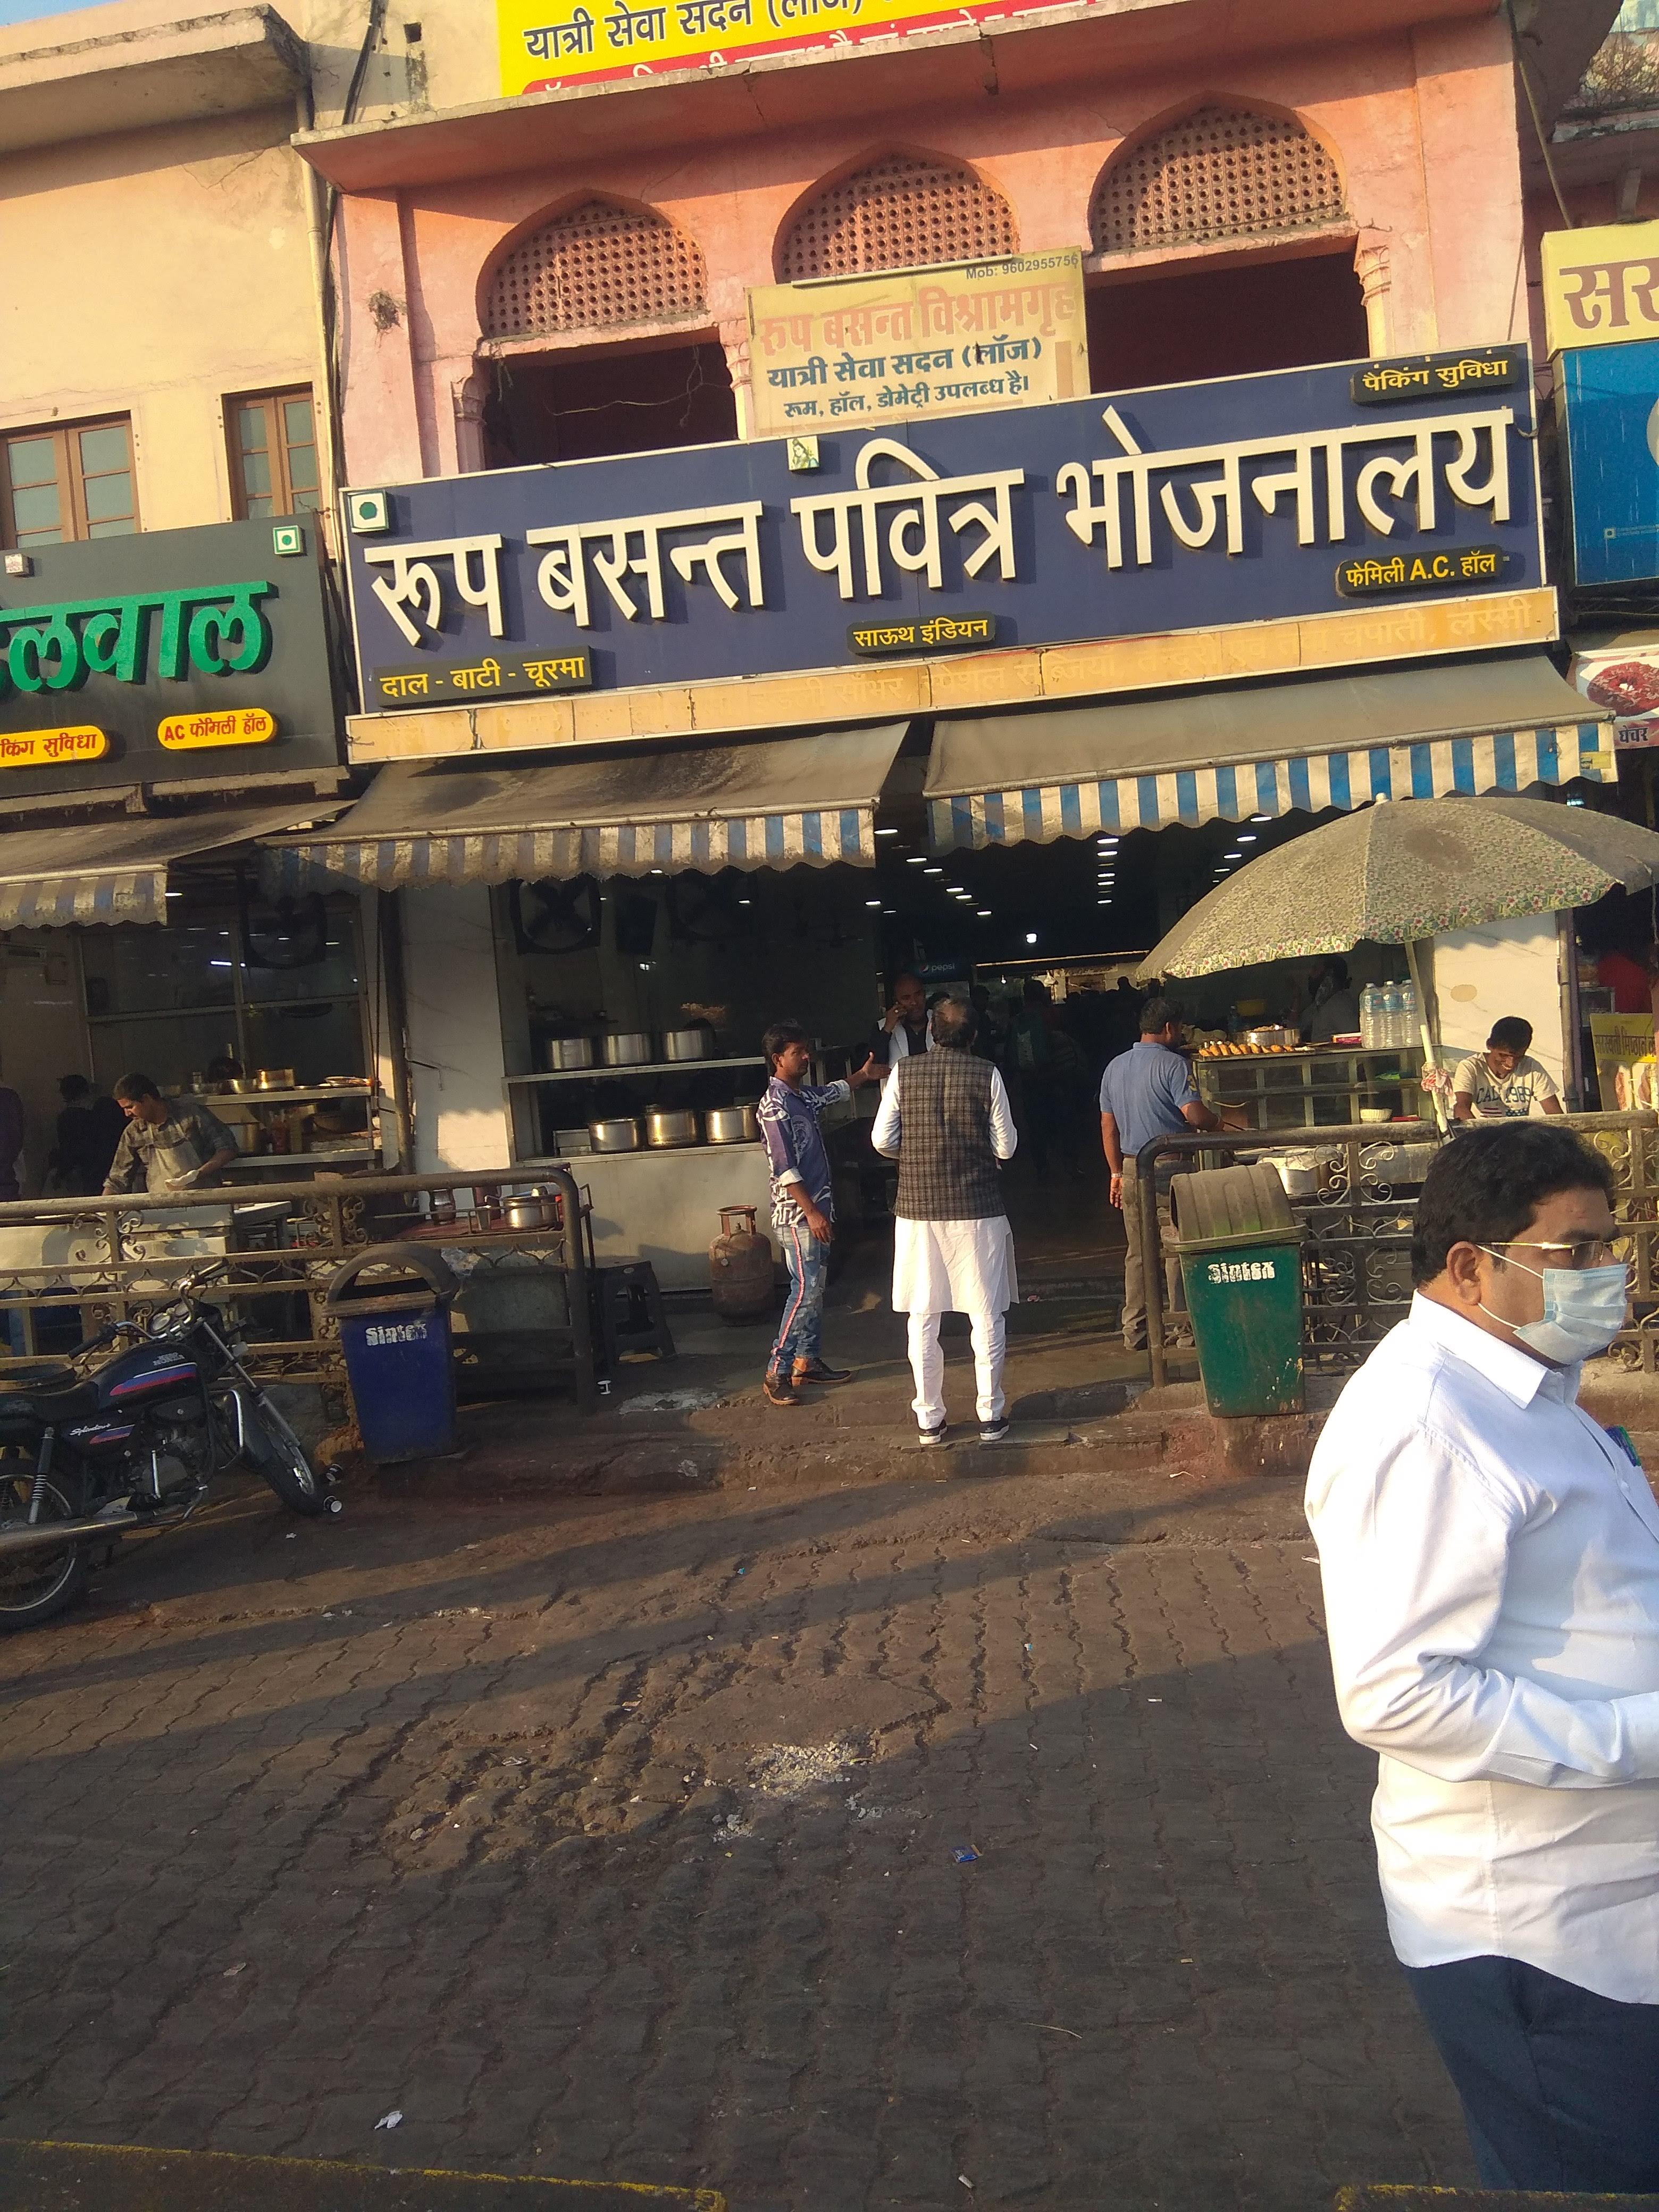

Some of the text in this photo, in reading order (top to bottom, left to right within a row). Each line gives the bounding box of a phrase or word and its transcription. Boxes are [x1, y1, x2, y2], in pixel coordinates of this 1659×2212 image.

[523, 7, 594, 60] यात्री
[605, 1, 666, 47] सेवा
[676, 0, 752, 35] सदन
[966, 254, 1079, 279] Mob: 9602955756
[821, 301, 913, 348] बसन्त
[918, 282, 1077, 339] विश्रामगृह
[766, 356, 828, 388] यात्री
[833, 352, 885, 382] सेवा
[891, 348, 954, 374] सदन
[1361, 359, 1509, 391] पैकिंग सुविधा
[934, 378, 1004, 401] उपलब्ध
[526, 500, 764, 627] बसन्त
[790, 438, 1025, 599] पवित्र
[1056, 405, 1514, 568] भोजनालय
[1345, 549, 1496, 587] फेमिली A.C. हॉल
[0, 581, 269, 691] लवाल
[852, 617, 988, 648] साऊथ इंडियन
[379, 673, 429, 698] दाल
[449, 657, 501, 690] बाटी
[522, 657, 585, 688] चूरमा
[164, 724, 186, 741] AC
[241, 713, 267, 735] हॉल
[42, 733, 97, 758] सुविधा
[931, 963, 955, 972] pepsi
[1208, 1261, 1275, 1284] Sintex
